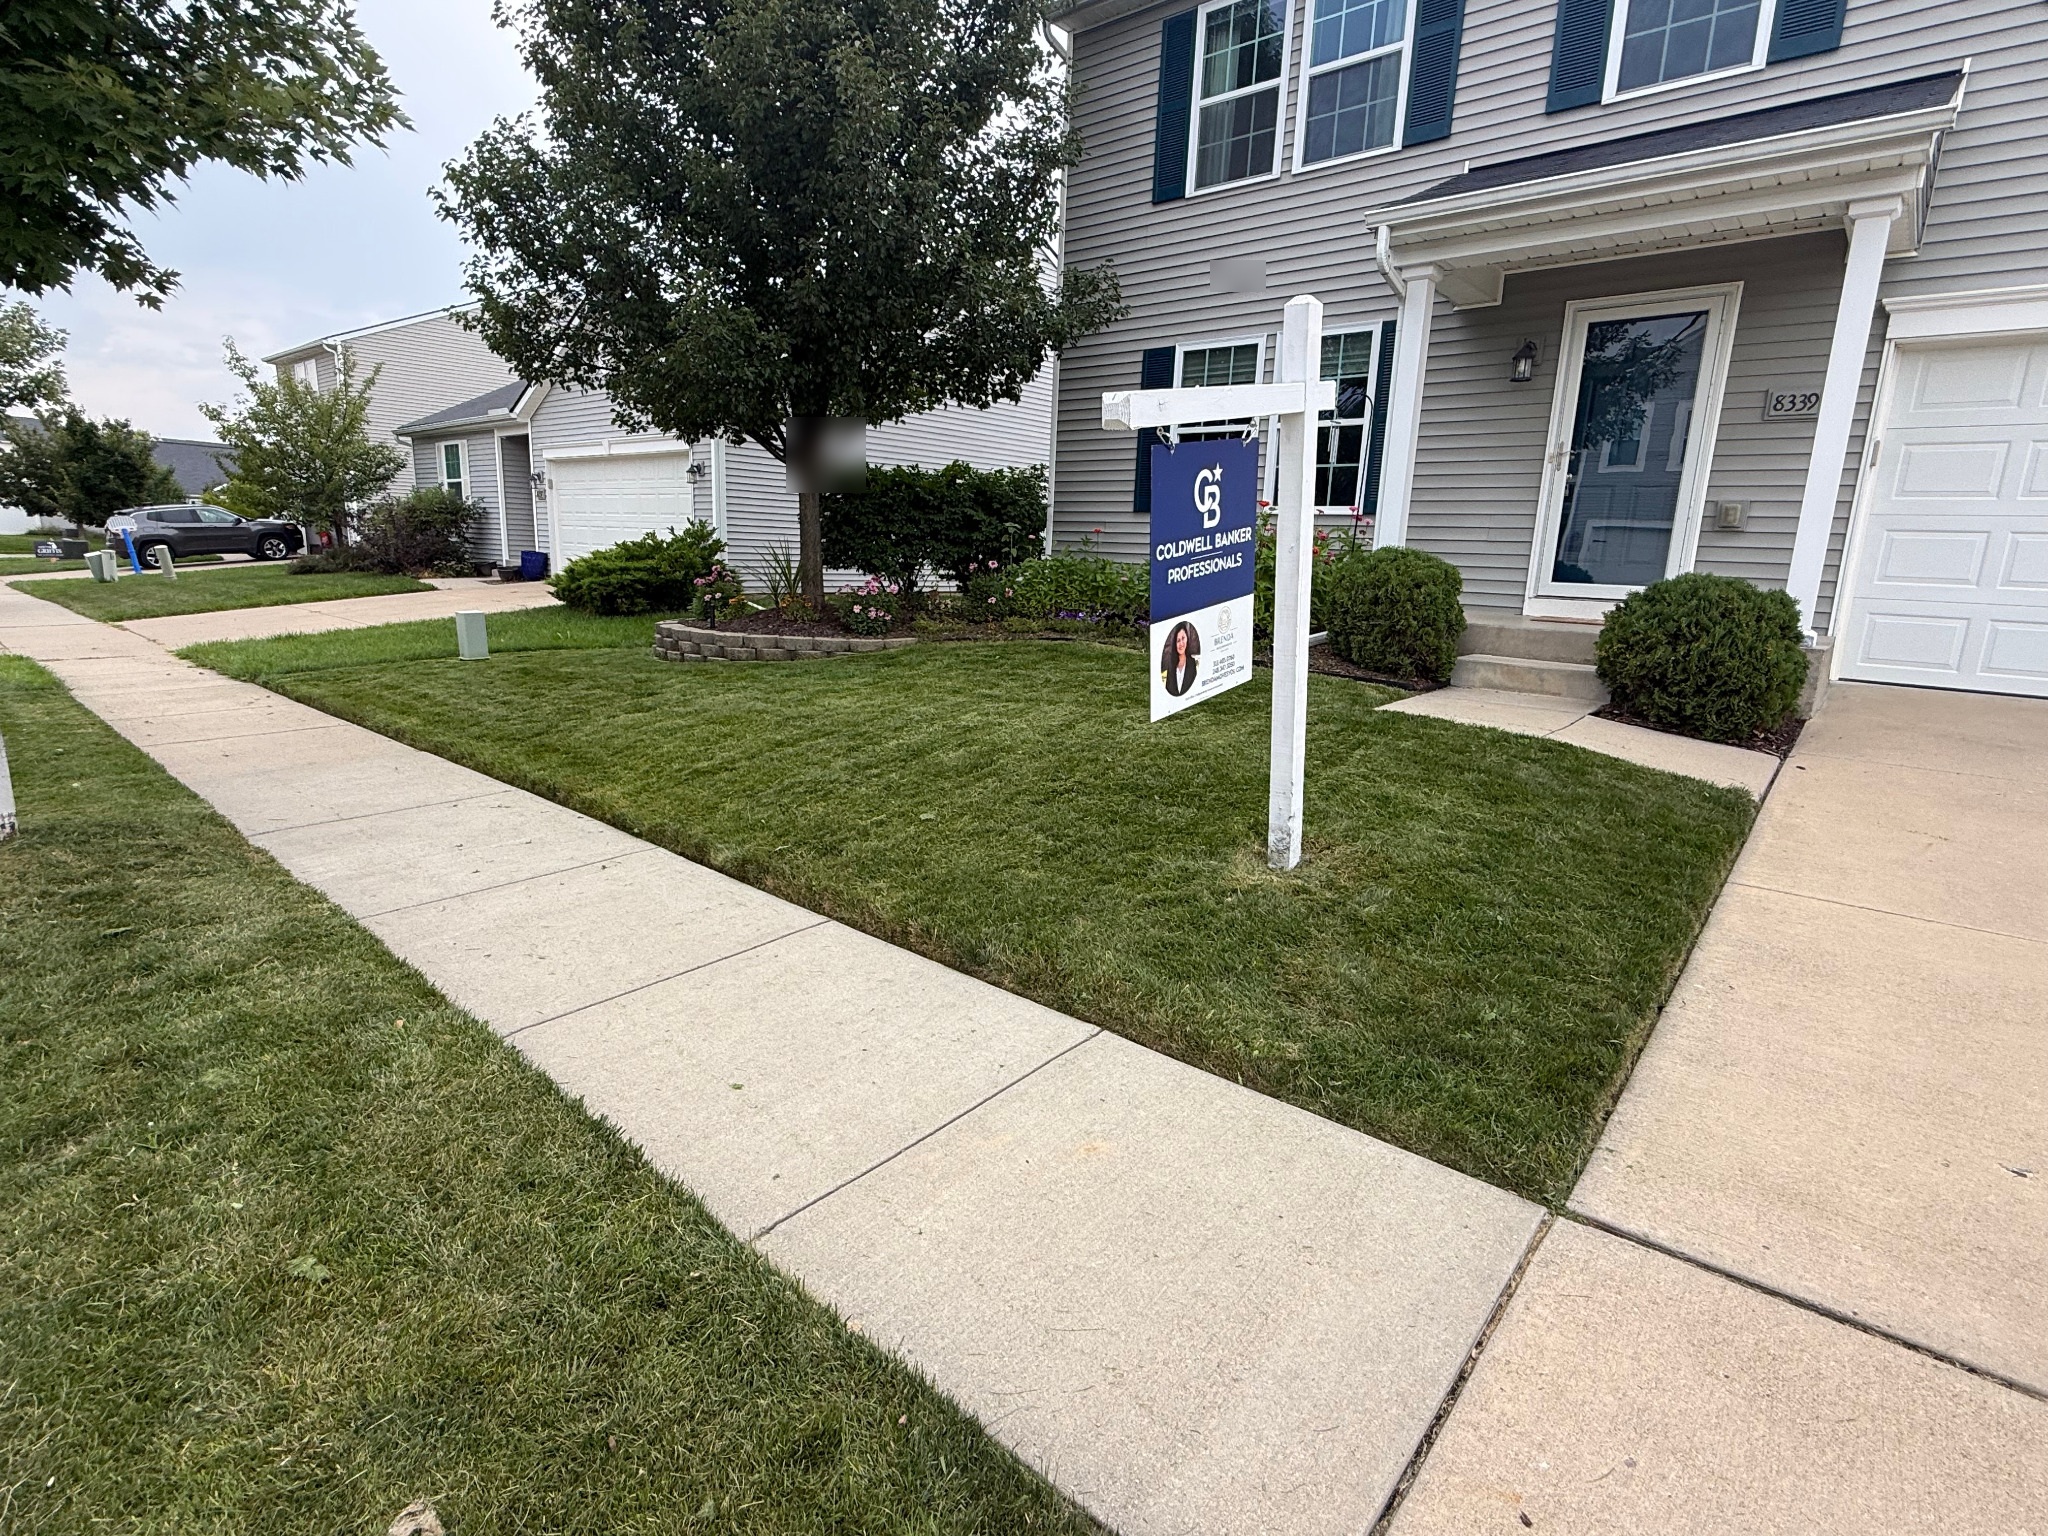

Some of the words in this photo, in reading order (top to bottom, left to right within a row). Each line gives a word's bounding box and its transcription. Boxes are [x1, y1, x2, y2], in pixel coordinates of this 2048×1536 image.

[1773, 393, 1820, 412] 8339
[1194, 468, 1220, 529] CB
[1156, 535, 1213, 561] COLDWELL
[1215, 527, 1252, 548] BANKER
[1168, 553, 1243, 584] PROFESSIONALS
